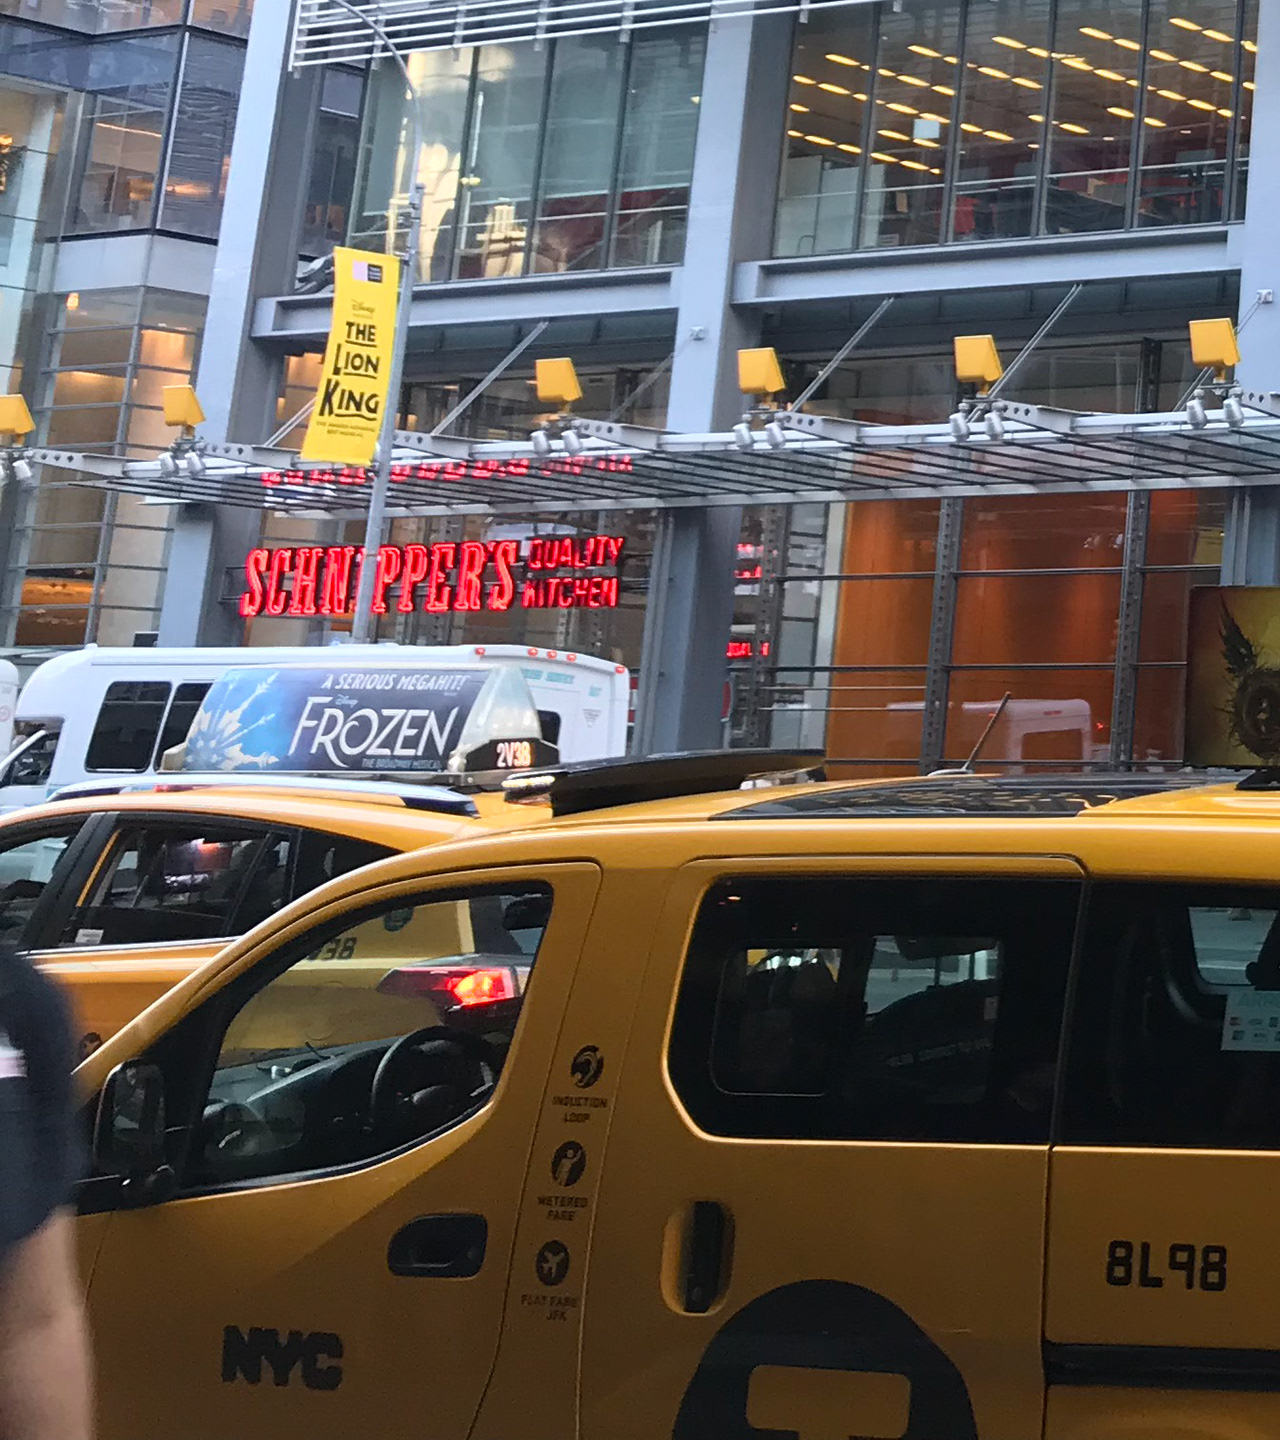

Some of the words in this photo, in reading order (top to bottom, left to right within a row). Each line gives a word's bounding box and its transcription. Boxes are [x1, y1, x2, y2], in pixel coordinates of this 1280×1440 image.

[345, 321, 377, 343] THE
[319, 378, 379, 417] KING
[527, 536, 624, 570] QUALITY
[240, 540, 518, 617] SCHNPPER'S
[522, 577, 619, 608] KITCHEN
[335, 674, 397, 690] SERIOUS
[288, 696, 459, 768] FROZEN
[1106, 1240, 1227, 1291] 8L98
[222, 1325, 343, 1391] NYC
